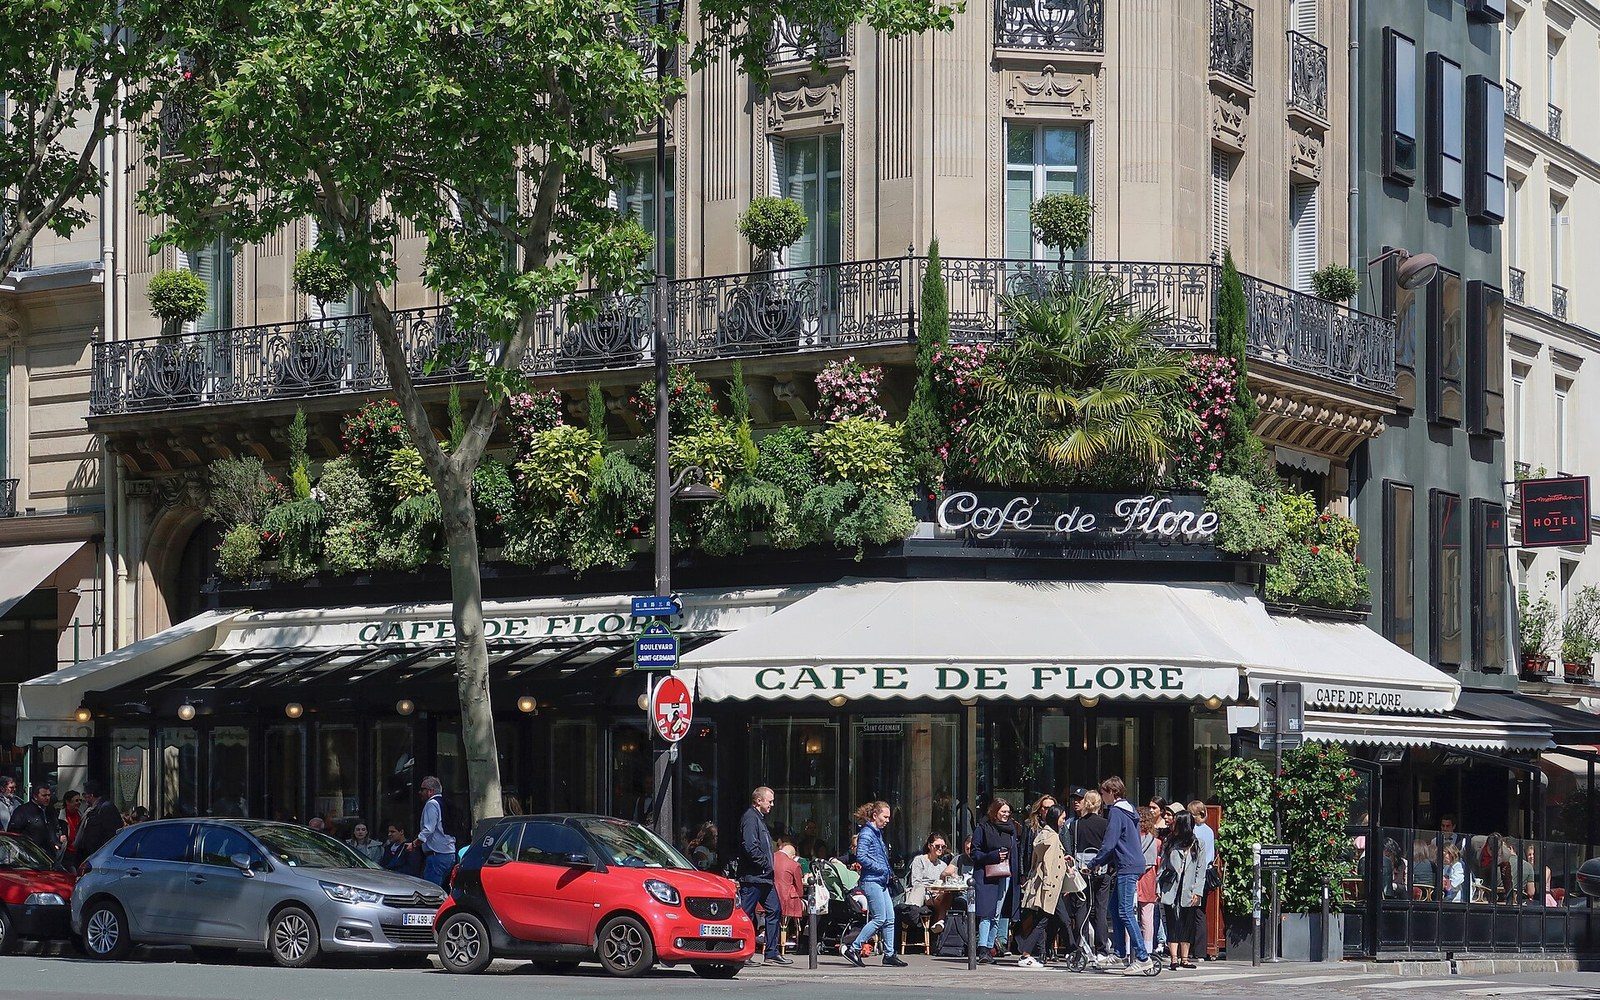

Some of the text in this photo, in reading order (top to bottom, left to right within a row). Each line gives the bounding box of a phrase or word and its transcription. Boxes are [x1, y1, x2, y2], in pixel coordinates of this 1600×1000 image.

[937, 491, 1219, 539] Café de Flore
[1533, 516, 1577, 527] HOTEL
[358, 613, 683, 642] CAFE DE FLOR
[638, 654, 676, 662] SAINT-GERMAIN
[754, 665, 1185, 690] CAFE DE FLORE
[1316, 688, 1402, 706] CAFE DE FLORE
